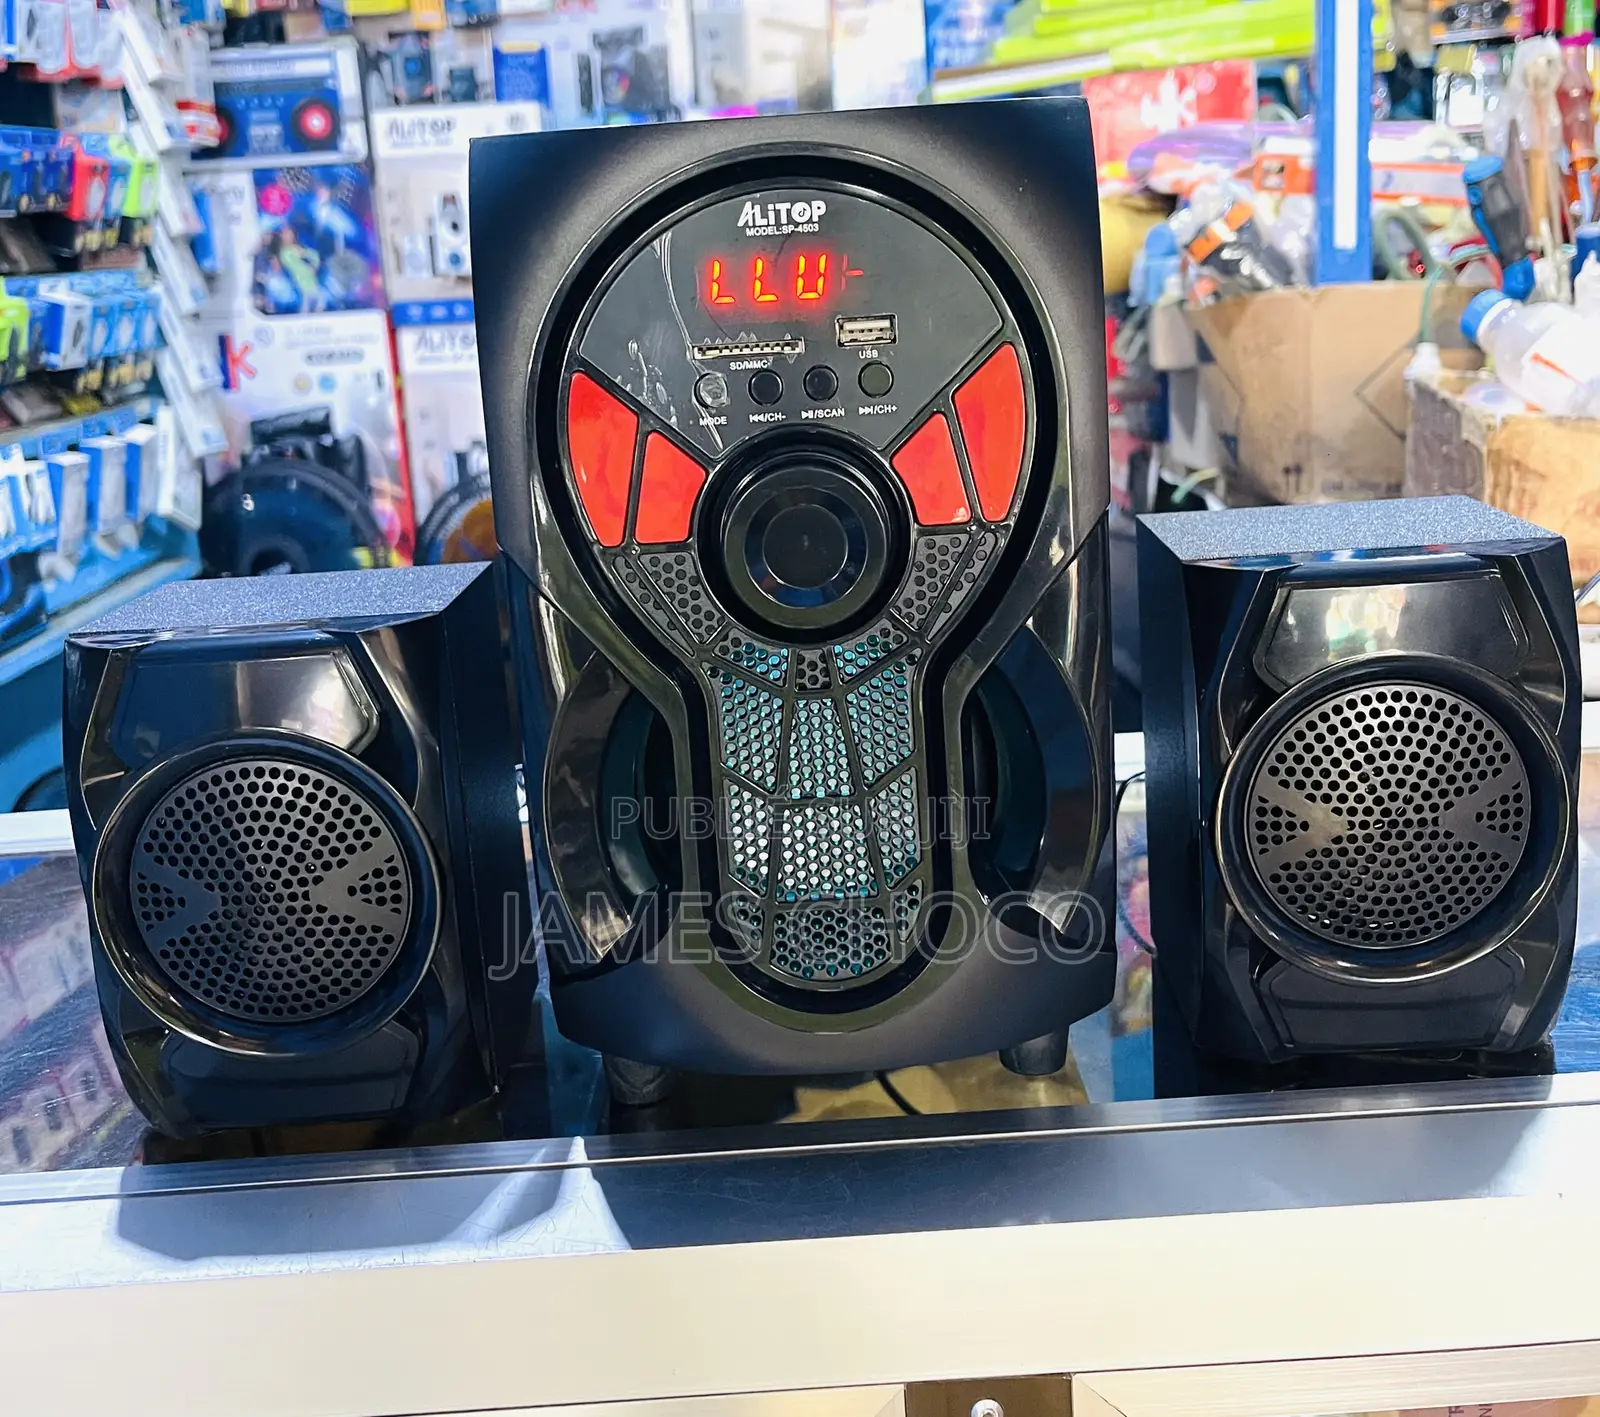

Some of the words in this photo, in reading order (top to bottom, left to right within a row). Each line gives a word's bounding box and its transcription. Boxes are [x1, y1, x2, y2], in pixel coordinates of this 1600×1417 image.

[745, 223, 820, 237] MODEL:SP-4503
[858, 349, 879, 359] USB
[729, 359, 769, 371] SD/MMC
[699, 416, 728, 426] MODE
